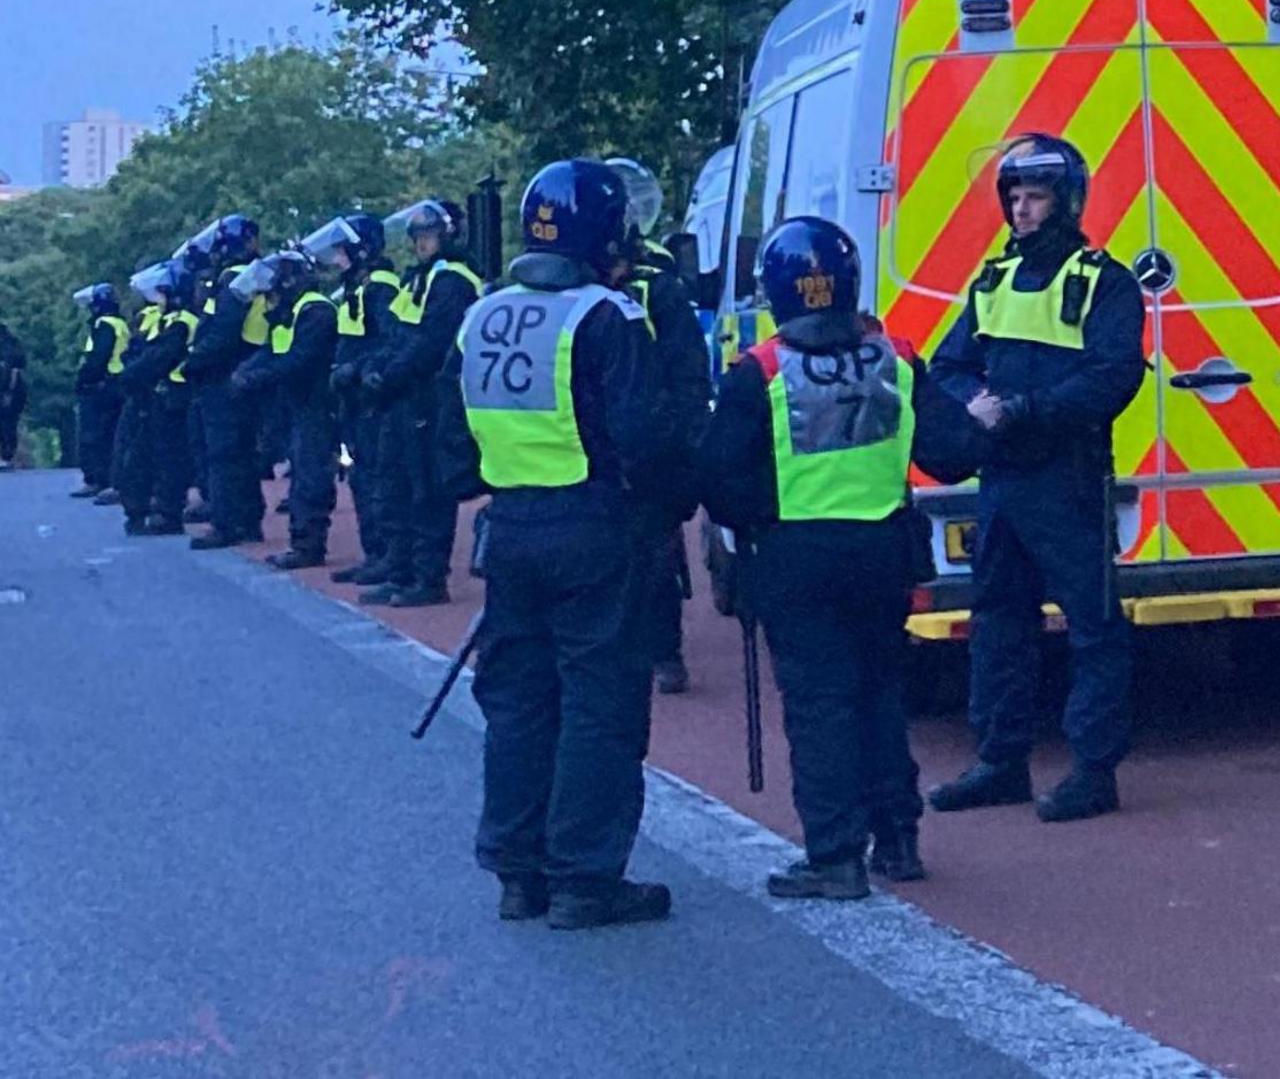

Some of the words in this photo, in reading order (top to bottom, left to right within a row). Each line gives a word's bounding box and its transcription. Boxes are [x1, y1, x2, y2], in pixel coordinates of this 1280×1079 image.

[480, 305, 547, 347] QP
[479, 351, 533, 395] 7C
[803, 342, 884, 386] QP
